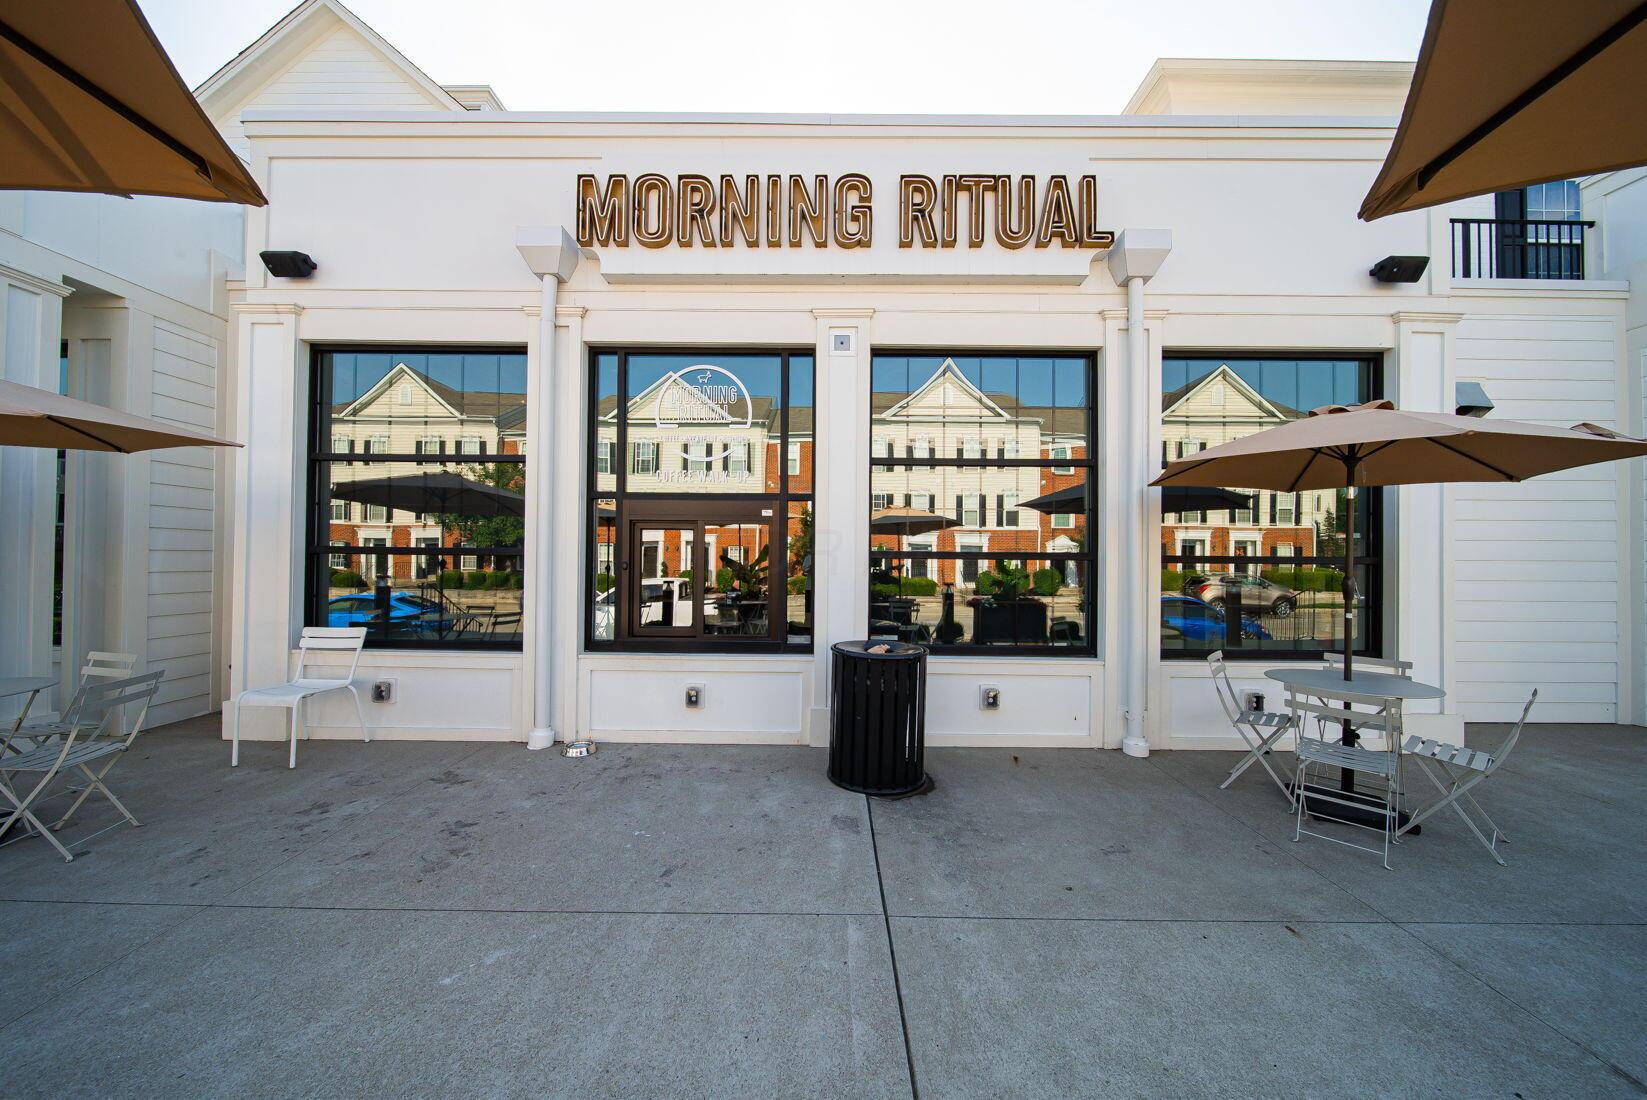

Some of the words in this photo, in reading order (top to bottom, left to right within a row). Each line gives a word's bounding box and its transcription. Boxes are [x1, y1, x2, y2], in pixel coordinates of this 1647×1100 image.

[576, 173, 872, 248] MORNING
[899, 174, 1115, 248] RITUAL
[671, 385, 738, 404] MORNING
[678, 404, 728, 421] RITUAL
[656, 470, 694, 484] COFFEE
